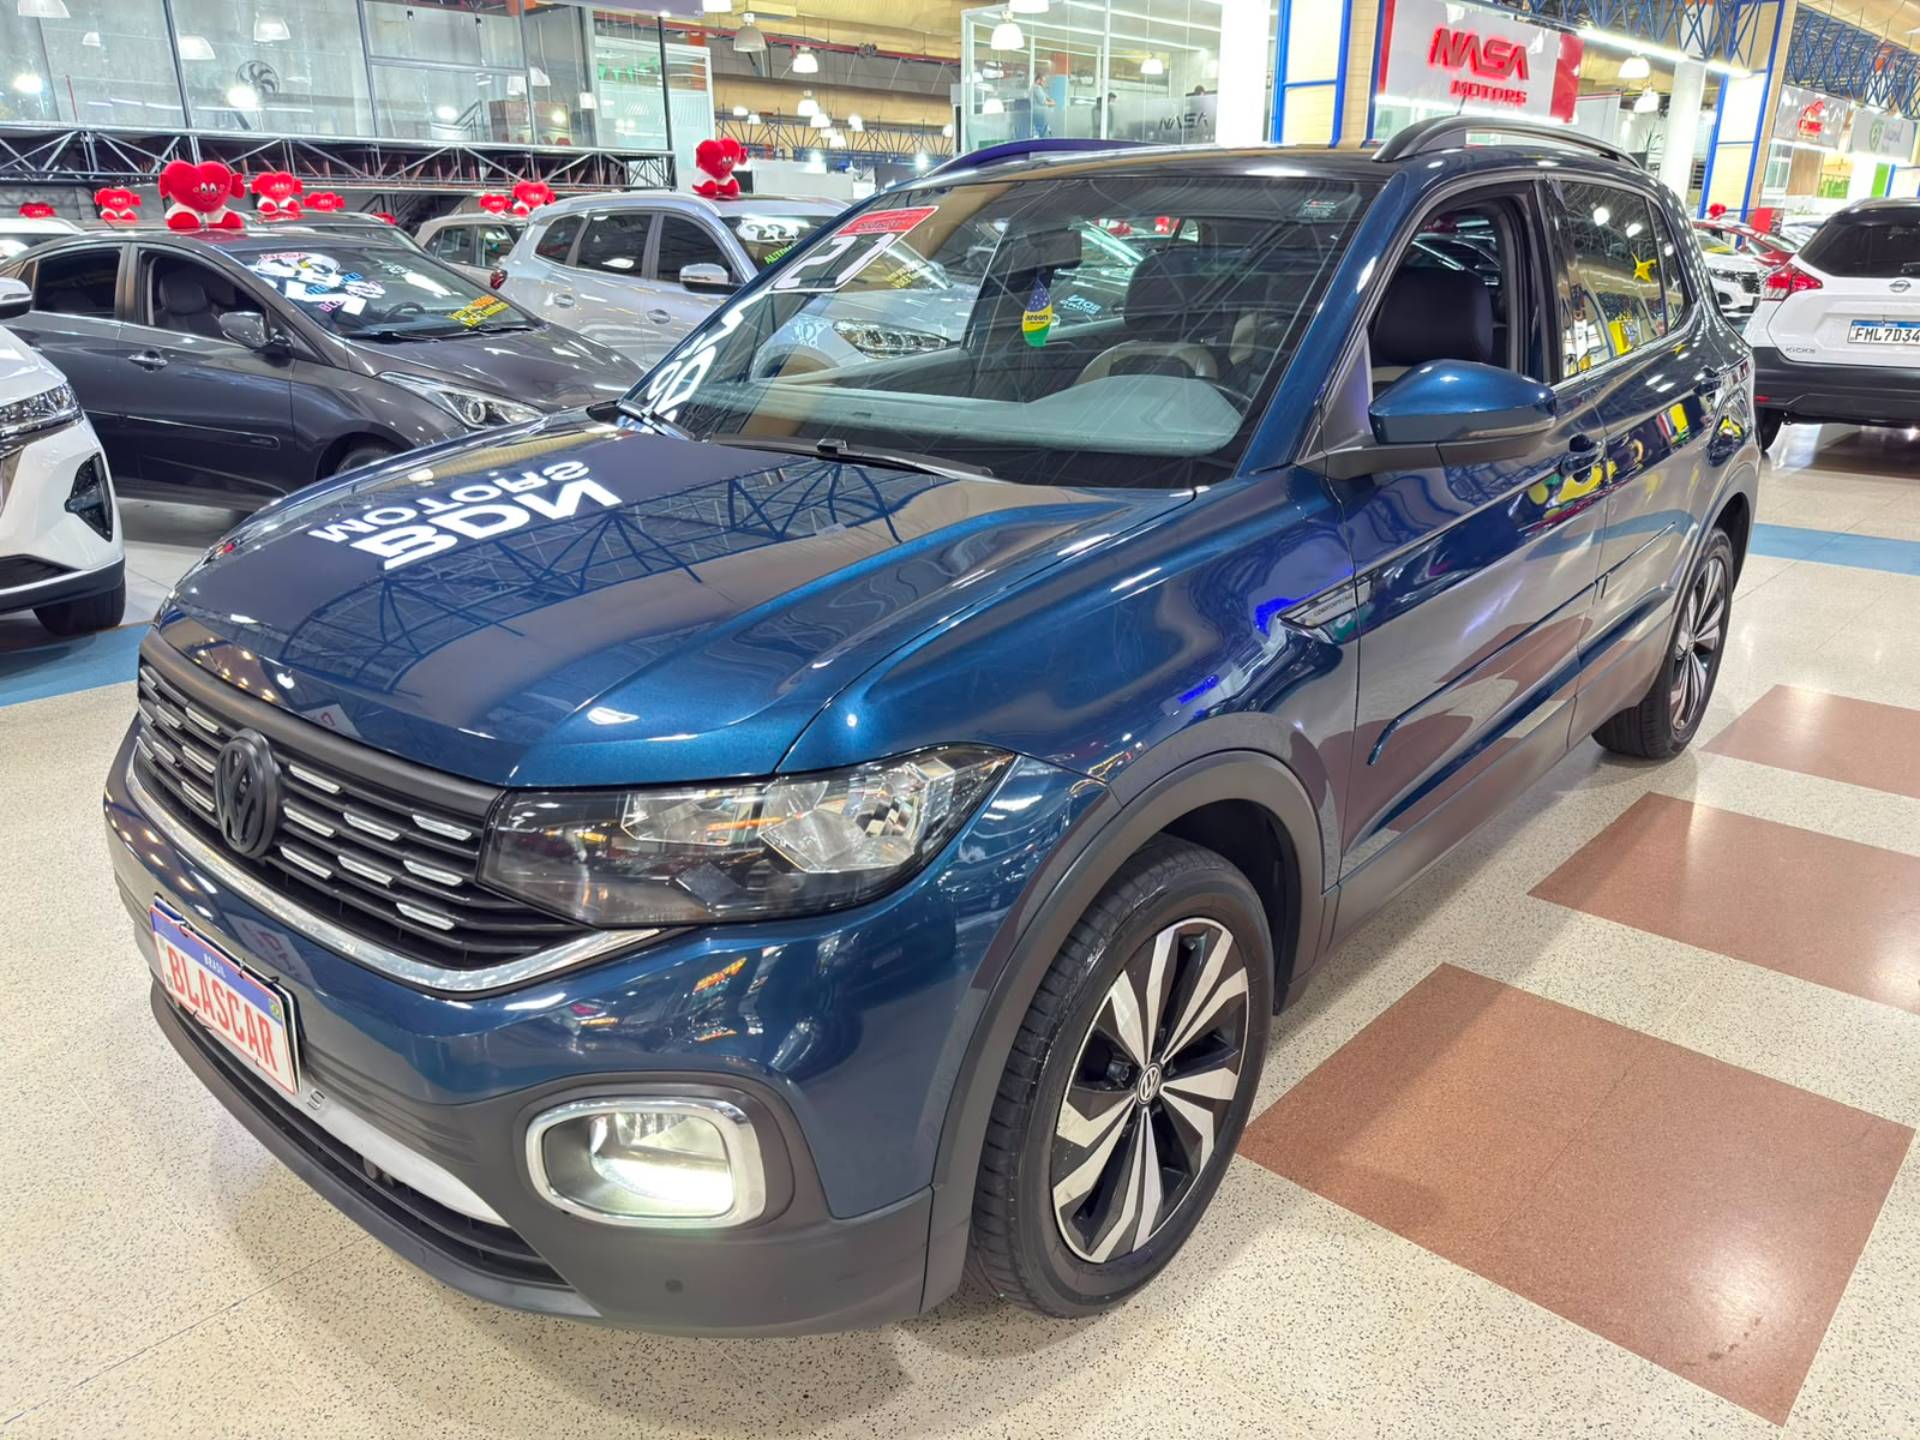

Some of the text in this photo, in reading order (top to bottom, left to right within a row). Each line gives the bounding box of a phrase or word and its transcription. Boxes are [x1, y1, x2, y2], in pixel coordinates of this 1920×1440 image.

[1429, 27, 1529, 81] NASA
[1451, 79, 1527, 105] MOTORS
[1159, 112, 1209, 131] NASA
[774, 233, 896, 289] 21
[167, 945, 279, 1073] BLASCAR
